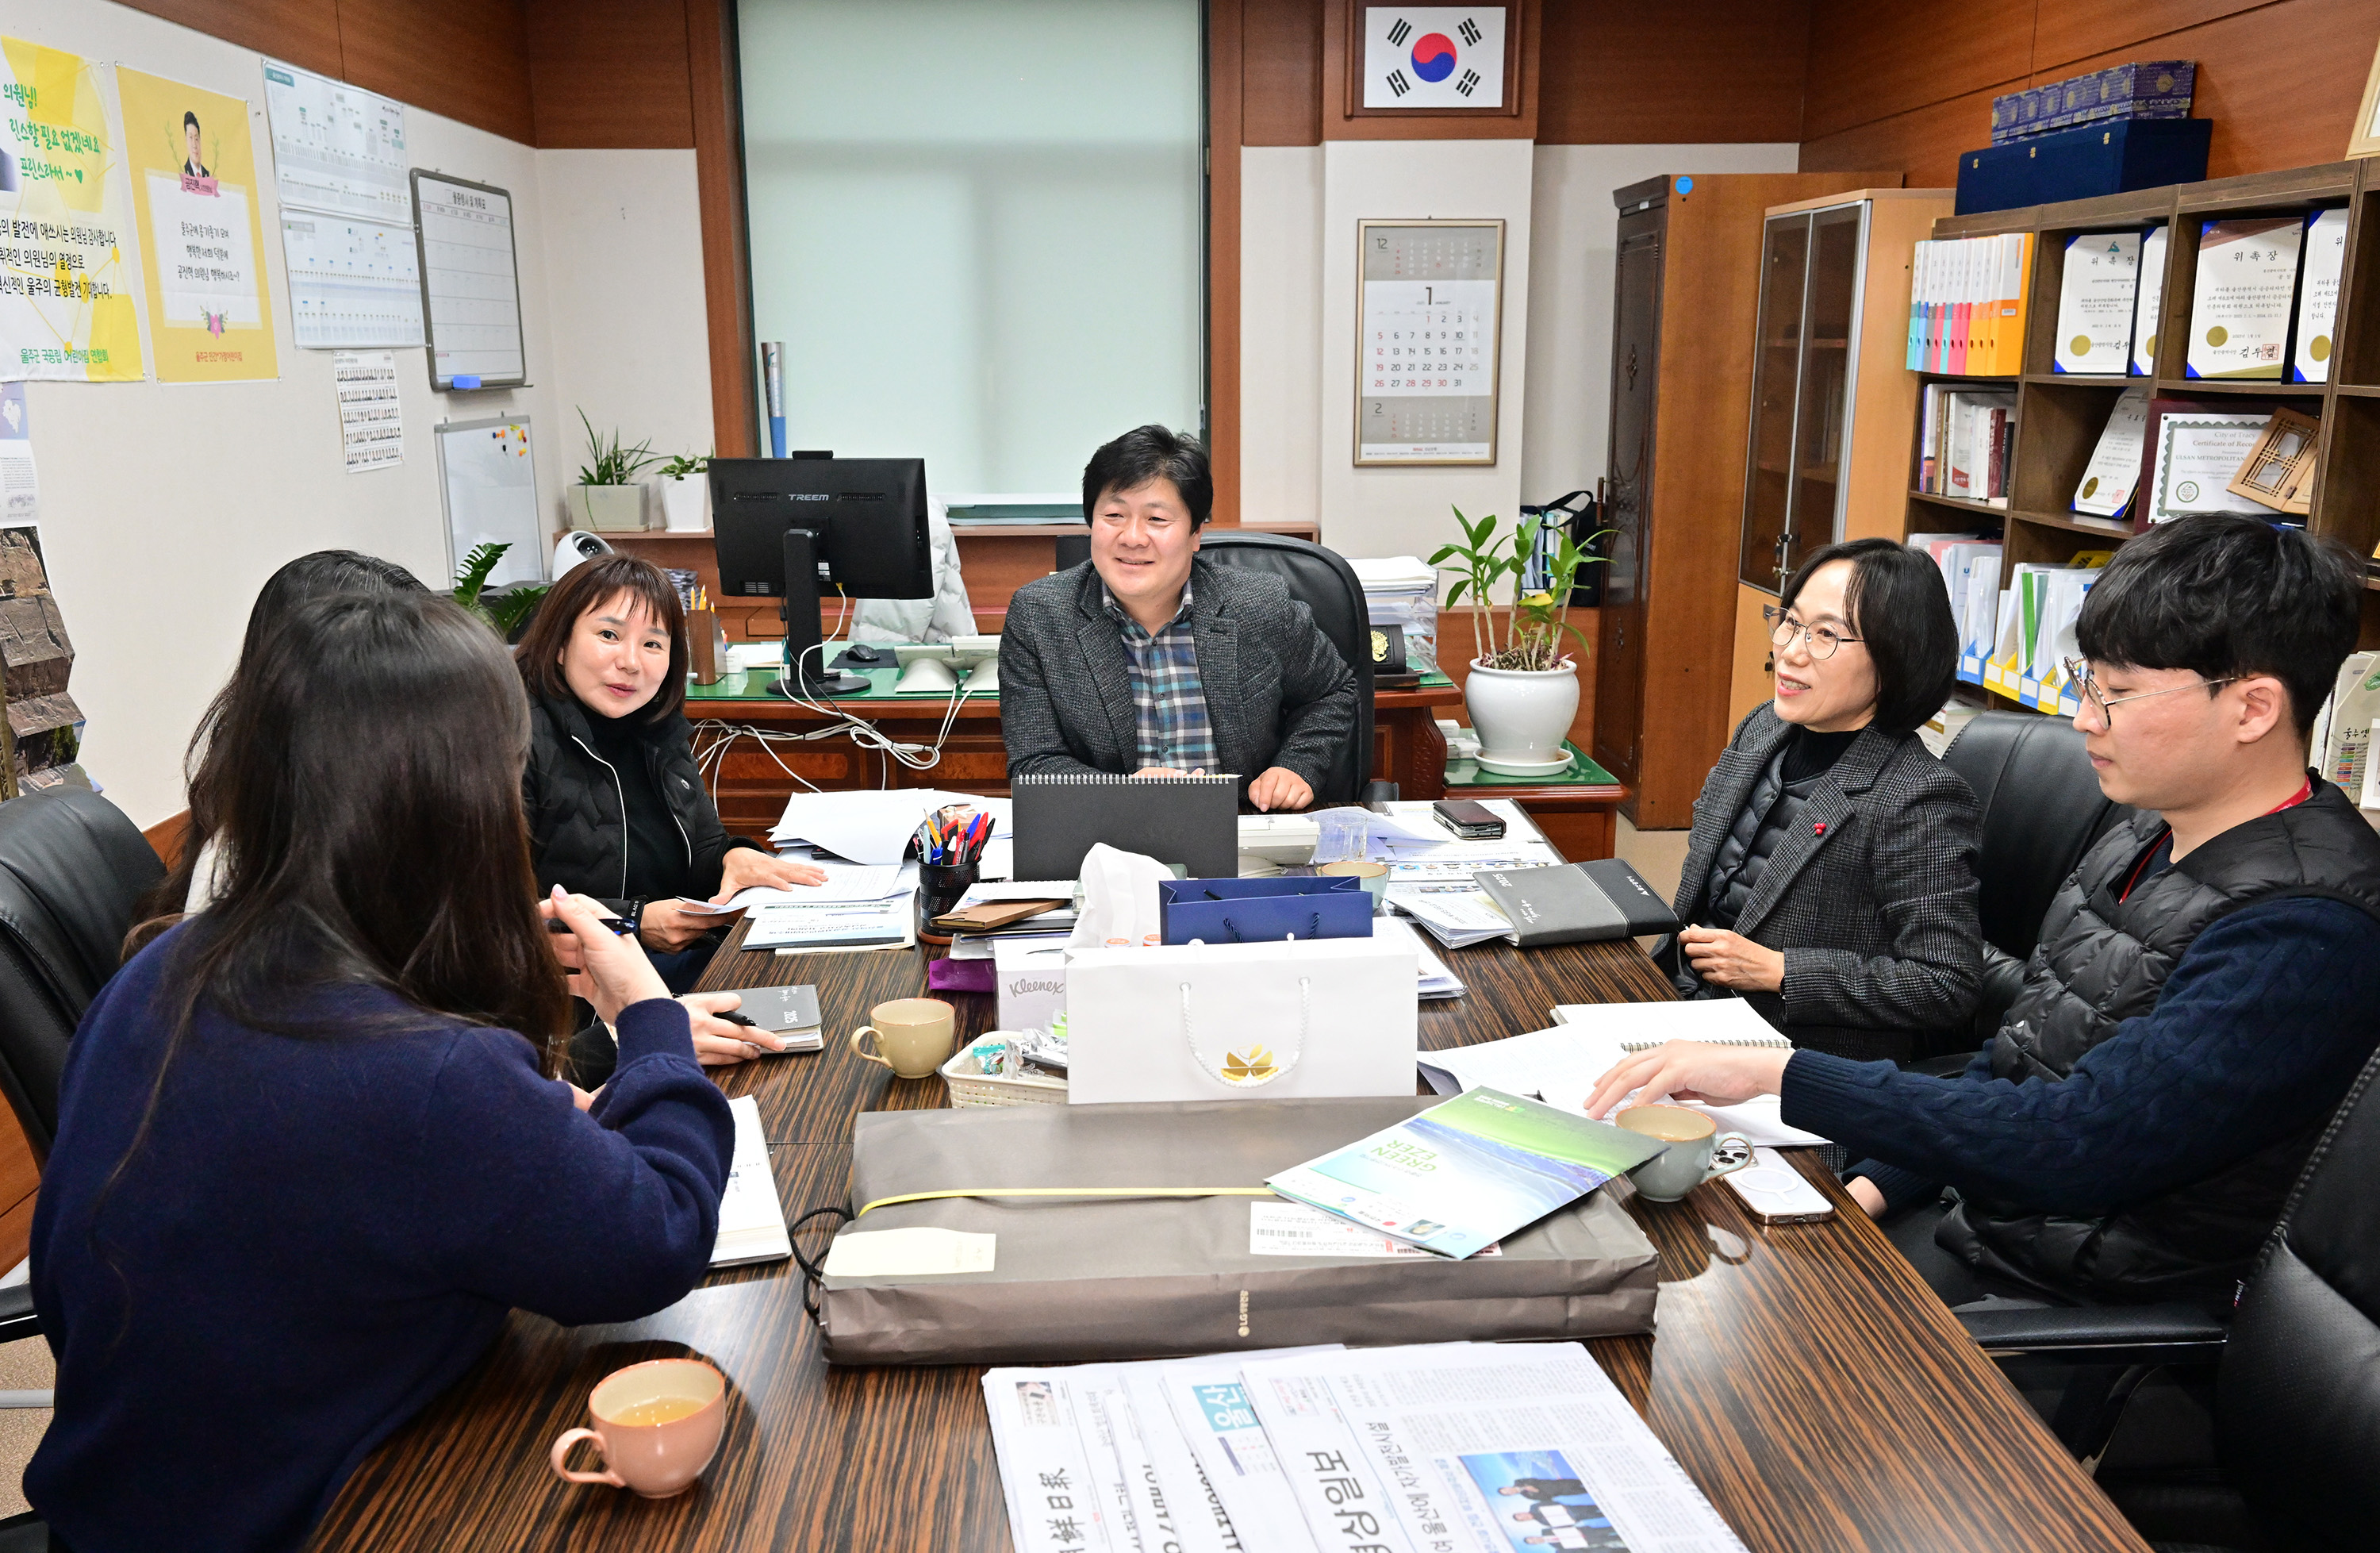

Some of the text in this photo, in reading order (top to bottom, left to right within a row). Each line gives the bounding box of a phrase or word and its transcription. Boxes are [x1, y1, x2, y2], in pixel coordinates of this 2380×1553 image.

[3, 83, 37, 110] 의원님!
[40, 125, 60, 150] 필요
[60, 129, 101, 155] 없겠네요
[20, 157, 64, 181] 프린스라서
[0, 218, 117, 248] 의 발전에 애쓰시는 의원님 감사합니다
[2335, 236, 2343, 247] 위
[1376, 238, 1388, 250] 12
[24, 249, 58, 269] 의원님의
[59, 252, 85, 271] 열정으로
[2234, 250, 2278, 262] 위 촉 장
[27, 277, 52, 296] 울주의
[53, 279, 82, 298] 균형발전
[83, 282, 113, 300] 기대합니다.
[1426, 286, 1433, 306] 1
[1426, 315, 1430, 324] 1
[1441, 315, 1447, 324] 2
[1457, 315, 1463, 324] 3
[1377, 331, 1384, 340] 5
[1394, 331, 1399, 340] 6
[1410, 331, 1415, 340] 7
[1425, 331, 1431, 340] 8
[1441, 331, 1446, 340] 9
[1455, 331, 1464, 340] 10
[20, 348, 109, 364] 울주군 국공립 어린이집 연합회
[2239, 346, 2249, 359] 김
[1375, 403, 1383, 414] 2
[2344, 727, 2359, 740] 울주
[1492, 873, 1513, 887] 2025
[1008, 978, 1065, 998] Kleenex
[783, 1009, 799, 1024] 2025
[1370, 1146, 1438, 1172] GREEN
[1387, 1140, 1438, 1161] EZER
[1201, 1386, 1255, 1428] 울산
[1365, 1421, 1420, 1490] 자가발전시설
[1406, 1492, 1448, 1536] 울산에
